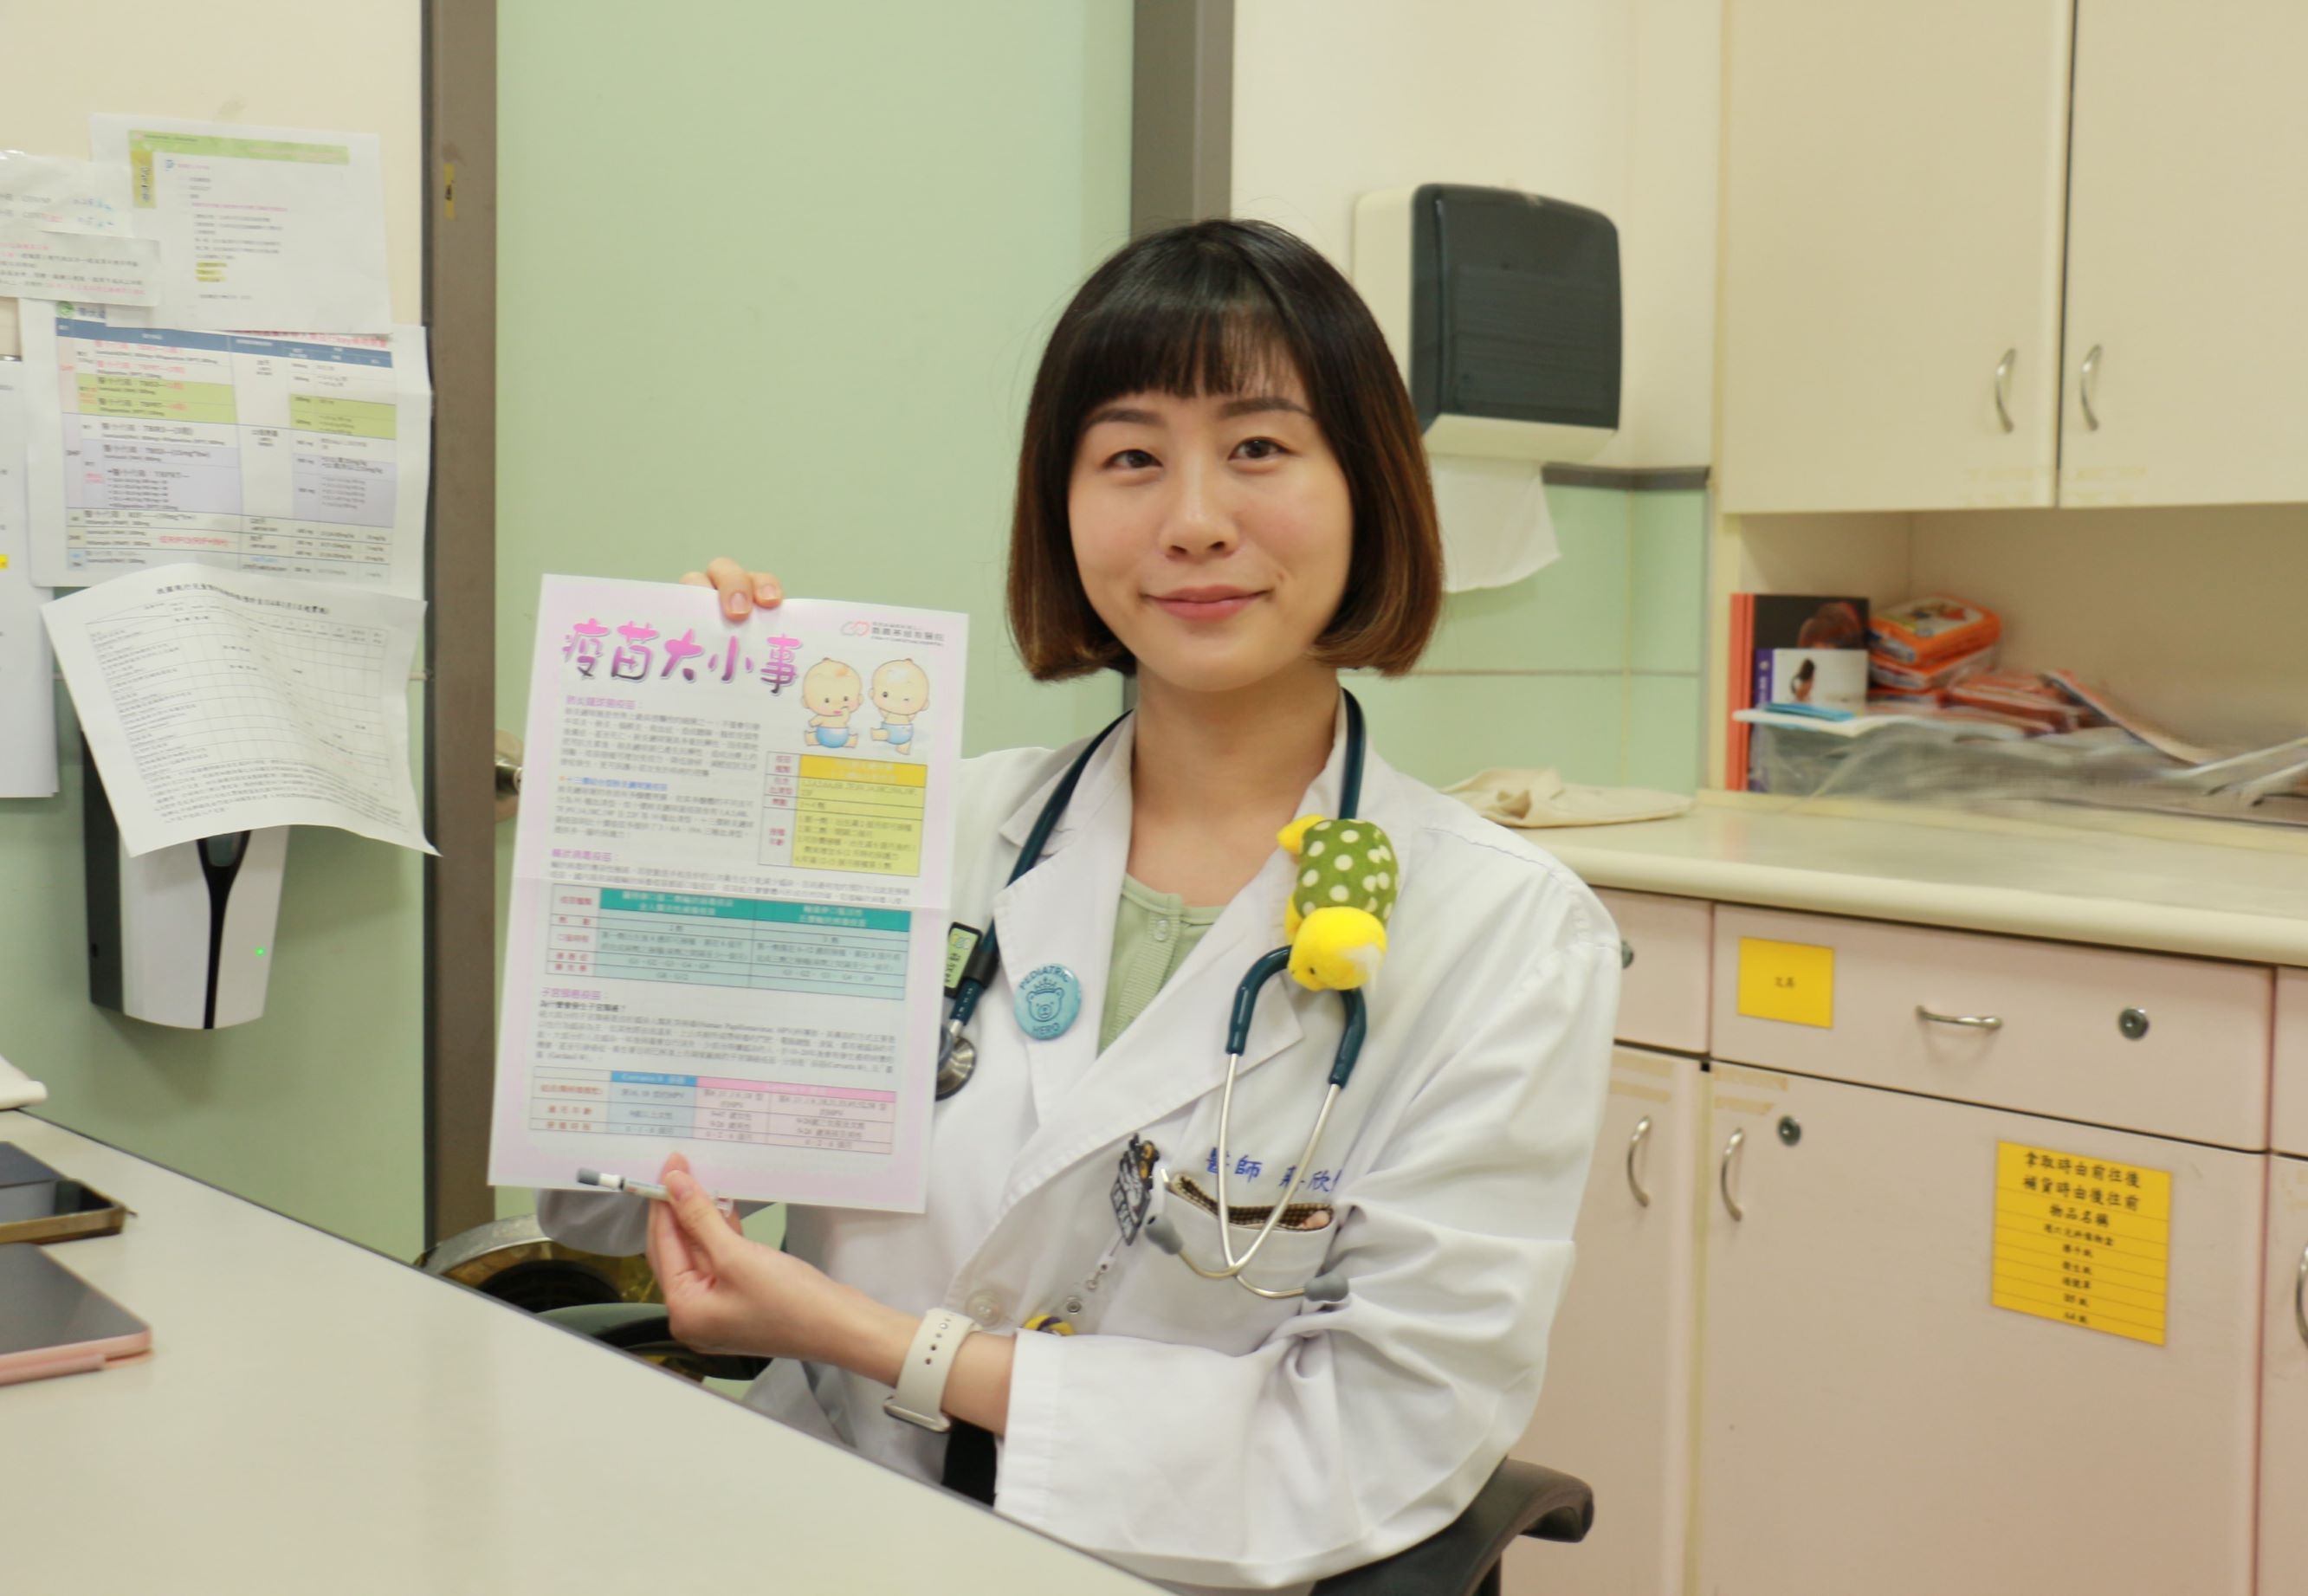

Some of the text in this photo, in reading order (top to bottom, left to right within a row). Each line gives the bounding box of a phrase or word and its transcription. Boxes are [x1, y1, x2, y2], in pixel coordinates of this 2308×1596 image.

[562, 617, 802, 695] 疫苗大小事
[1018, 964, 1070, 991] PEDIATRIC
[1031, 1023, 1061, 1035] HERO
[2025, 1151, 2141, 1188] 拿取時由前往後
[2023, 1175, 2140, 1212] 補貨時由後往前
[2049, 1204, 2110, 1228] 物品名稱
